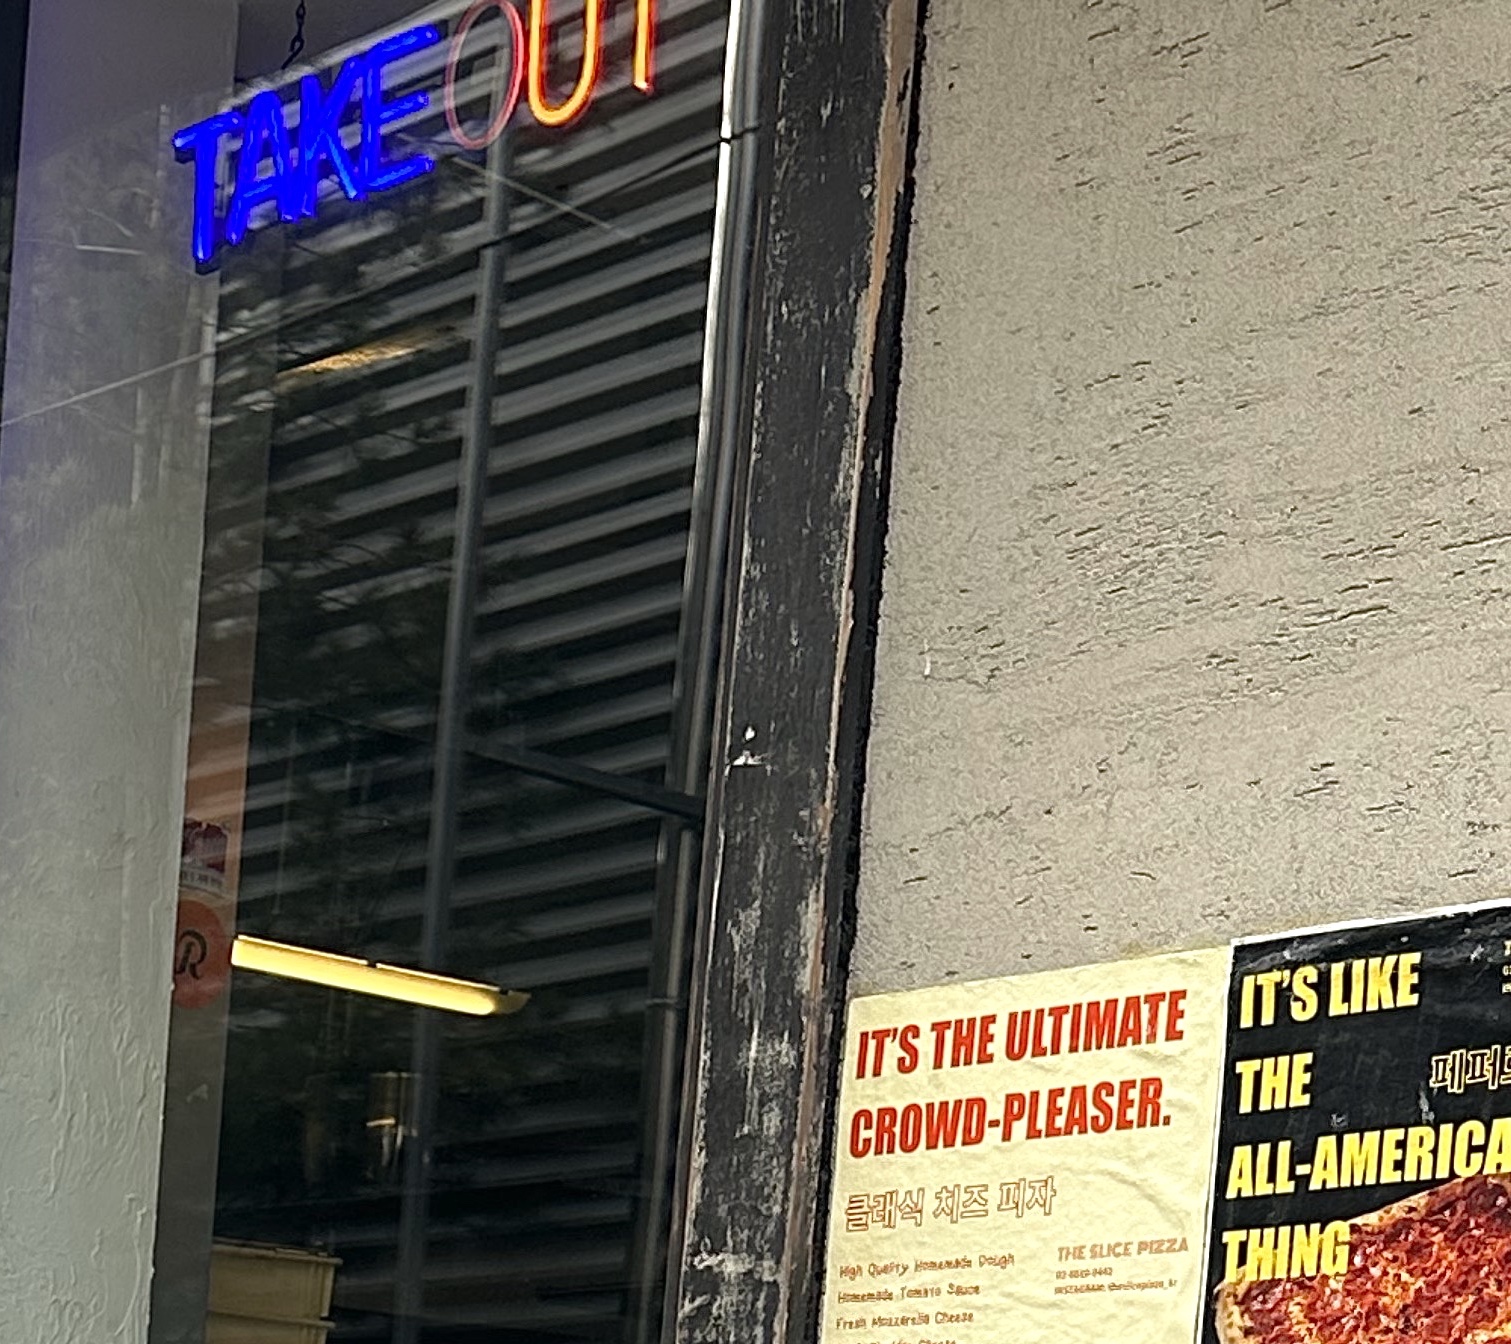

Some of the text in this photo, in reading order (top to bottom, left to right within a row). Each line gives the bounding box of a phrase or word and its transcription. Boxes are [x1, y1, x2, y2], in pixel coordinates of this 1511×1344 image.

[172, 24, 439, 263] TAKE
[1239, 951, 1422, 1029] IT'S LIKE
[855, 989, 1187, 1080] IT'S THE ULTIMATE
[849, 1077, 1171, 1160] CROWD-PLEASER.
[1235, 1052, 1314, 1115] THE
[845, 1176, 1056, 1233] 클래식 치즈 피자
[1058, 1237, 1189, 1262] THE SLICE PIZZA
[1222, 1220, 1351, 1284] THING
